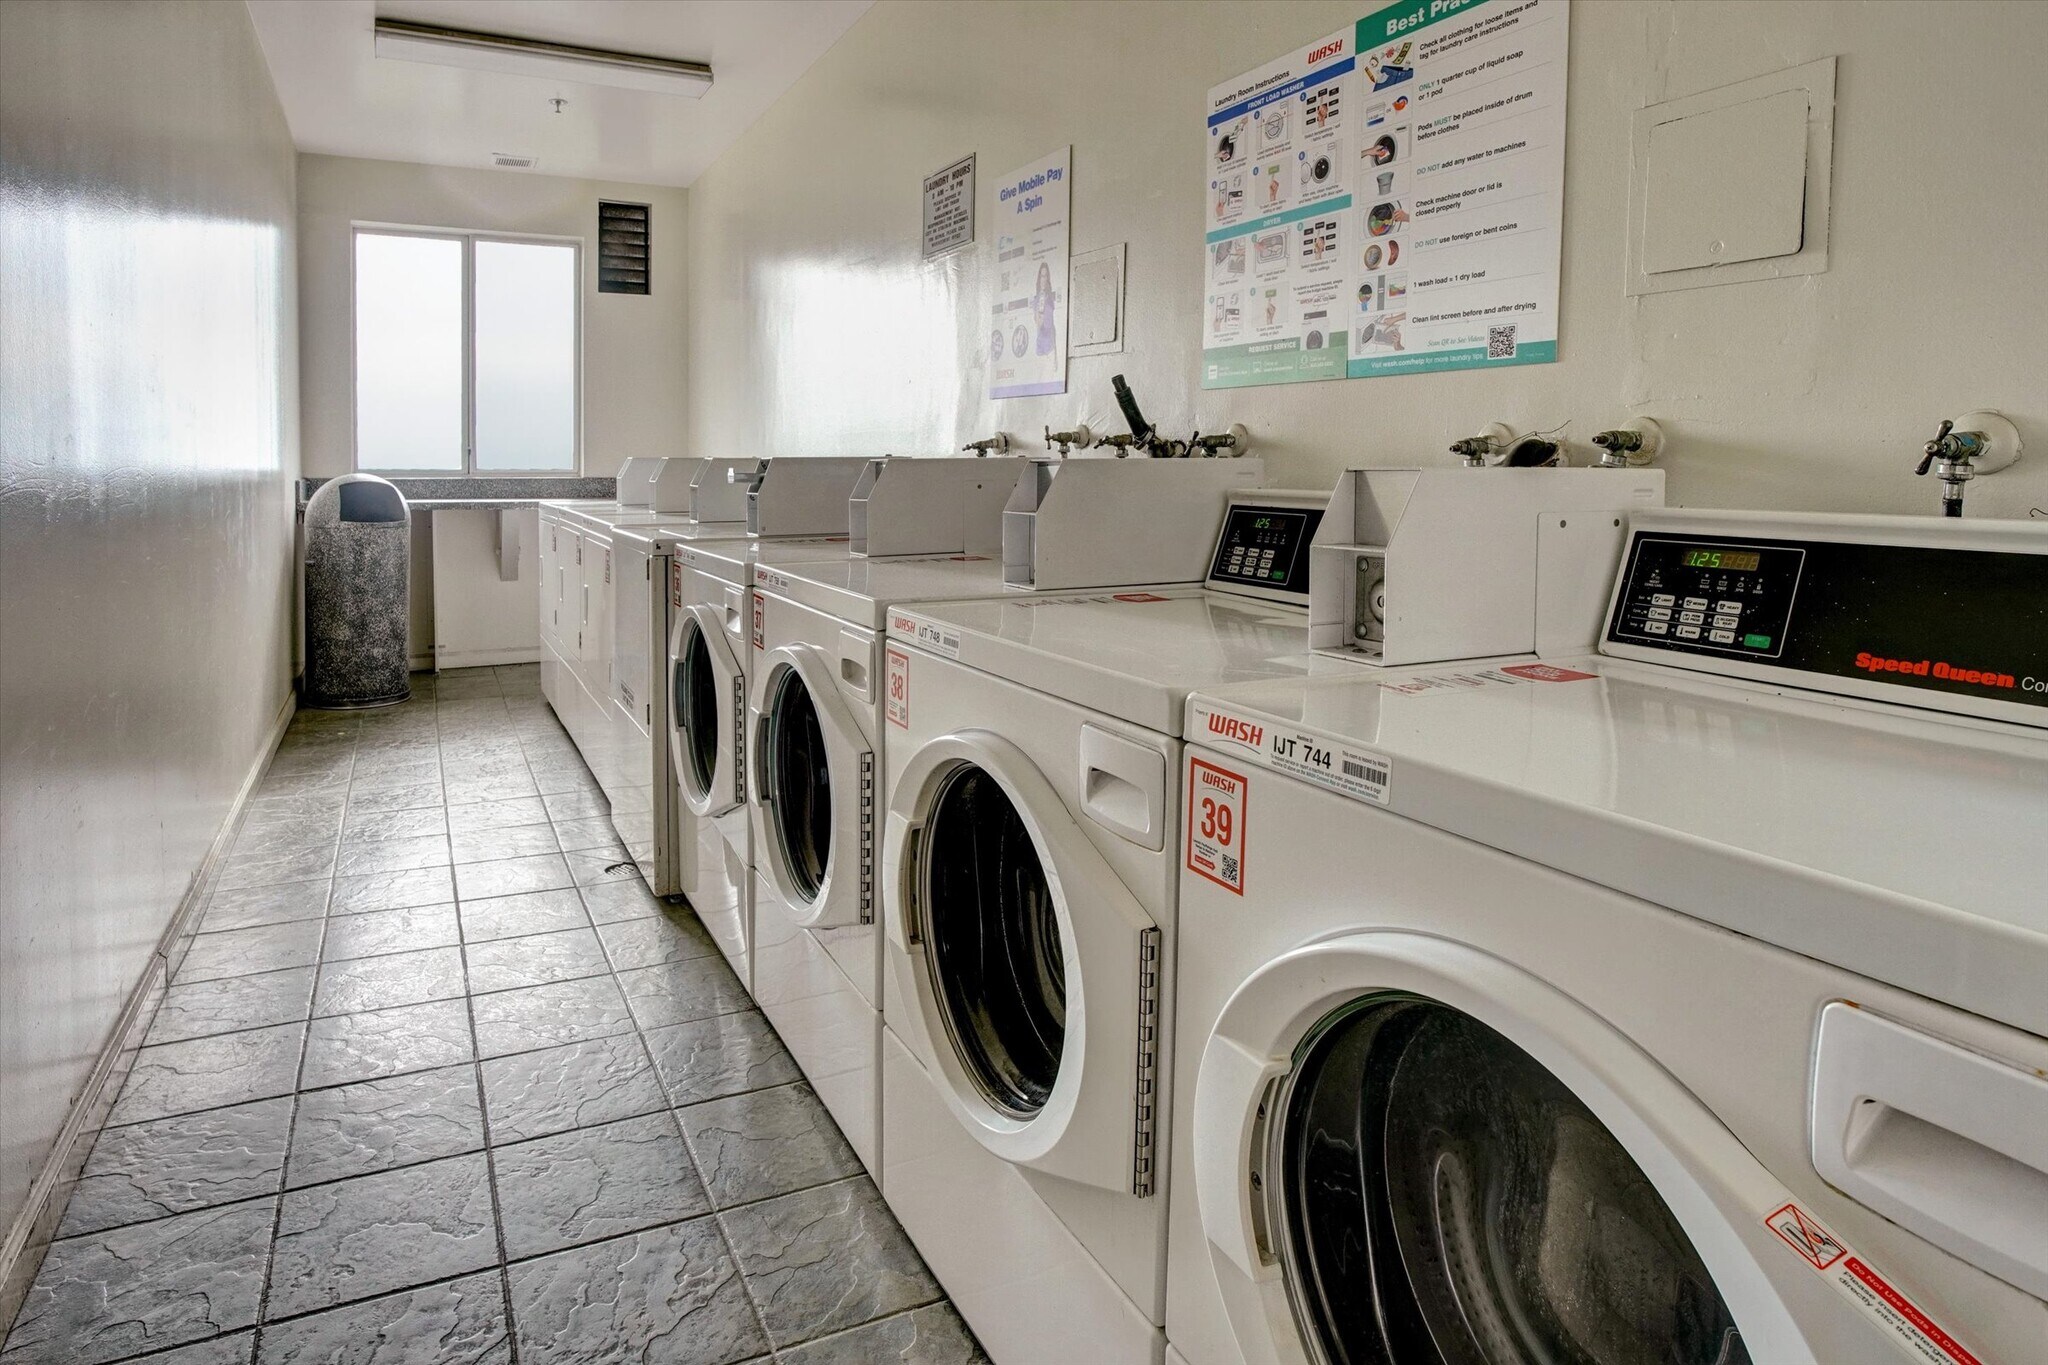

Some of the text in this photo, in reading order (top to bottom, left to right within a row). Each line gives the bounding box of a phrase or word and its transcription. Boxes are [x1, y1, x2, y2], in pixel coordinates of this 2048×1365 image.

[1386, 7, 1425, 36] Best
[1419, 0, 1538, 51] Check all clothing for loose items and
[1308, 39, 1343, 64] WASH
[1419, 17, 1519, 61] tag for laundry care instructions
[1418, 81, 1435, 92] ONLY
[1441, 71, 1464, 86] quarter
[1464, 66, 1477, 77] cup
[1478, 62, 1486, 71] of
[1486, 56, 1505, 69] liquid
[1506, 50, 1524, 61] soap
[1215, 70, 1290, 107] Laundry Room Instructions
[1247, 81, 1305, 110] FRONT LOAD WASHER
[1430, 87, 1443, 99] pod
[1417, 123, 1433, 132] Pods
[1434, 115, 1452, 127] MUST
[1462, 106, 1484, 120] placed
[1484, 100, 1505, 111] inside
[1506, 95, 1514, 104] of
[1514, 91, 1533, 101] drum
[1417, 123, 1460, 141] before clothes
[1416, 168, 1427, 176] DO
[1427, 163, 1440, 173] NOT
[1441, 159, 1453, 169] add
[1454, 158, 1465, 167] any
[1466, 152, 1485, 162] water
[1493, 141, 1527, 155] machines
[1000, 167, 1063, 202] Give Mobile Pay
[1415, 198, 1435, 208] Check
[1435, 191, 1461, 203] machine
[1462, 188, 1477, 197] door
[1486, 182, 1495, 191] lid
[1496, 181, 1503, 189] is
[1016, 194, 1043, 215] A Spin
[1415, 200, 1462, 217] closed properly
[1414, 241, 1424, 249] DO
[1424, 237, 1439, 247] NOT
[1439, 236, 1451, 244] use
[1451, 230, 1474, 242] foreign
[1483, 225, 1498, 235] bent
[1499, 222, 1518, 232] coins
[1418, 278, 1434, 287] wash
[1435, 275, 1448, 285] load
[1460, 272, 1470, 282] dry
[1471, 269, 1486, 279] load
[1412, 301, 1537, 324] Clean lint screen before and after drying
[1248, 340, 1297, 353] REQUEST SERVICE
[1457, 336, 1467, 344] See
[1370, 361, 1382, 369] Visit
[1383, 358, 1425, 368] wash.com/help
[1450, 354, 1472, 362] laundry
[1472, 353, 1484, 361] tips
[1689, 552, 1721, 568] 1.25
[894, 616, 916, 634] WASH
[919, 626, 928, 639] IJT
[1855, 651, 1930, 676] Speed
[1932, 662, 2015, 688] Queen
[891, 671, 904, 701] 38
[1208, 712, 1264, 747] WASH
[1273, 735, 1331, 770] IJT 744
[1202, 770, 1236, 794] WASH
[1201, 796, 1233, 847] 39
[1839, 1277, 1874, 1307] directly
[1874, 1308, 1894, 1325] into
[1895, 1325, 1913, 1341] the
[1843, 1271, 1876, 1300] Please
[1877, 1301, 1906, 1326] insert
[1851, 1262, 1975, 1365] Do Not Use Pods in Dispe
